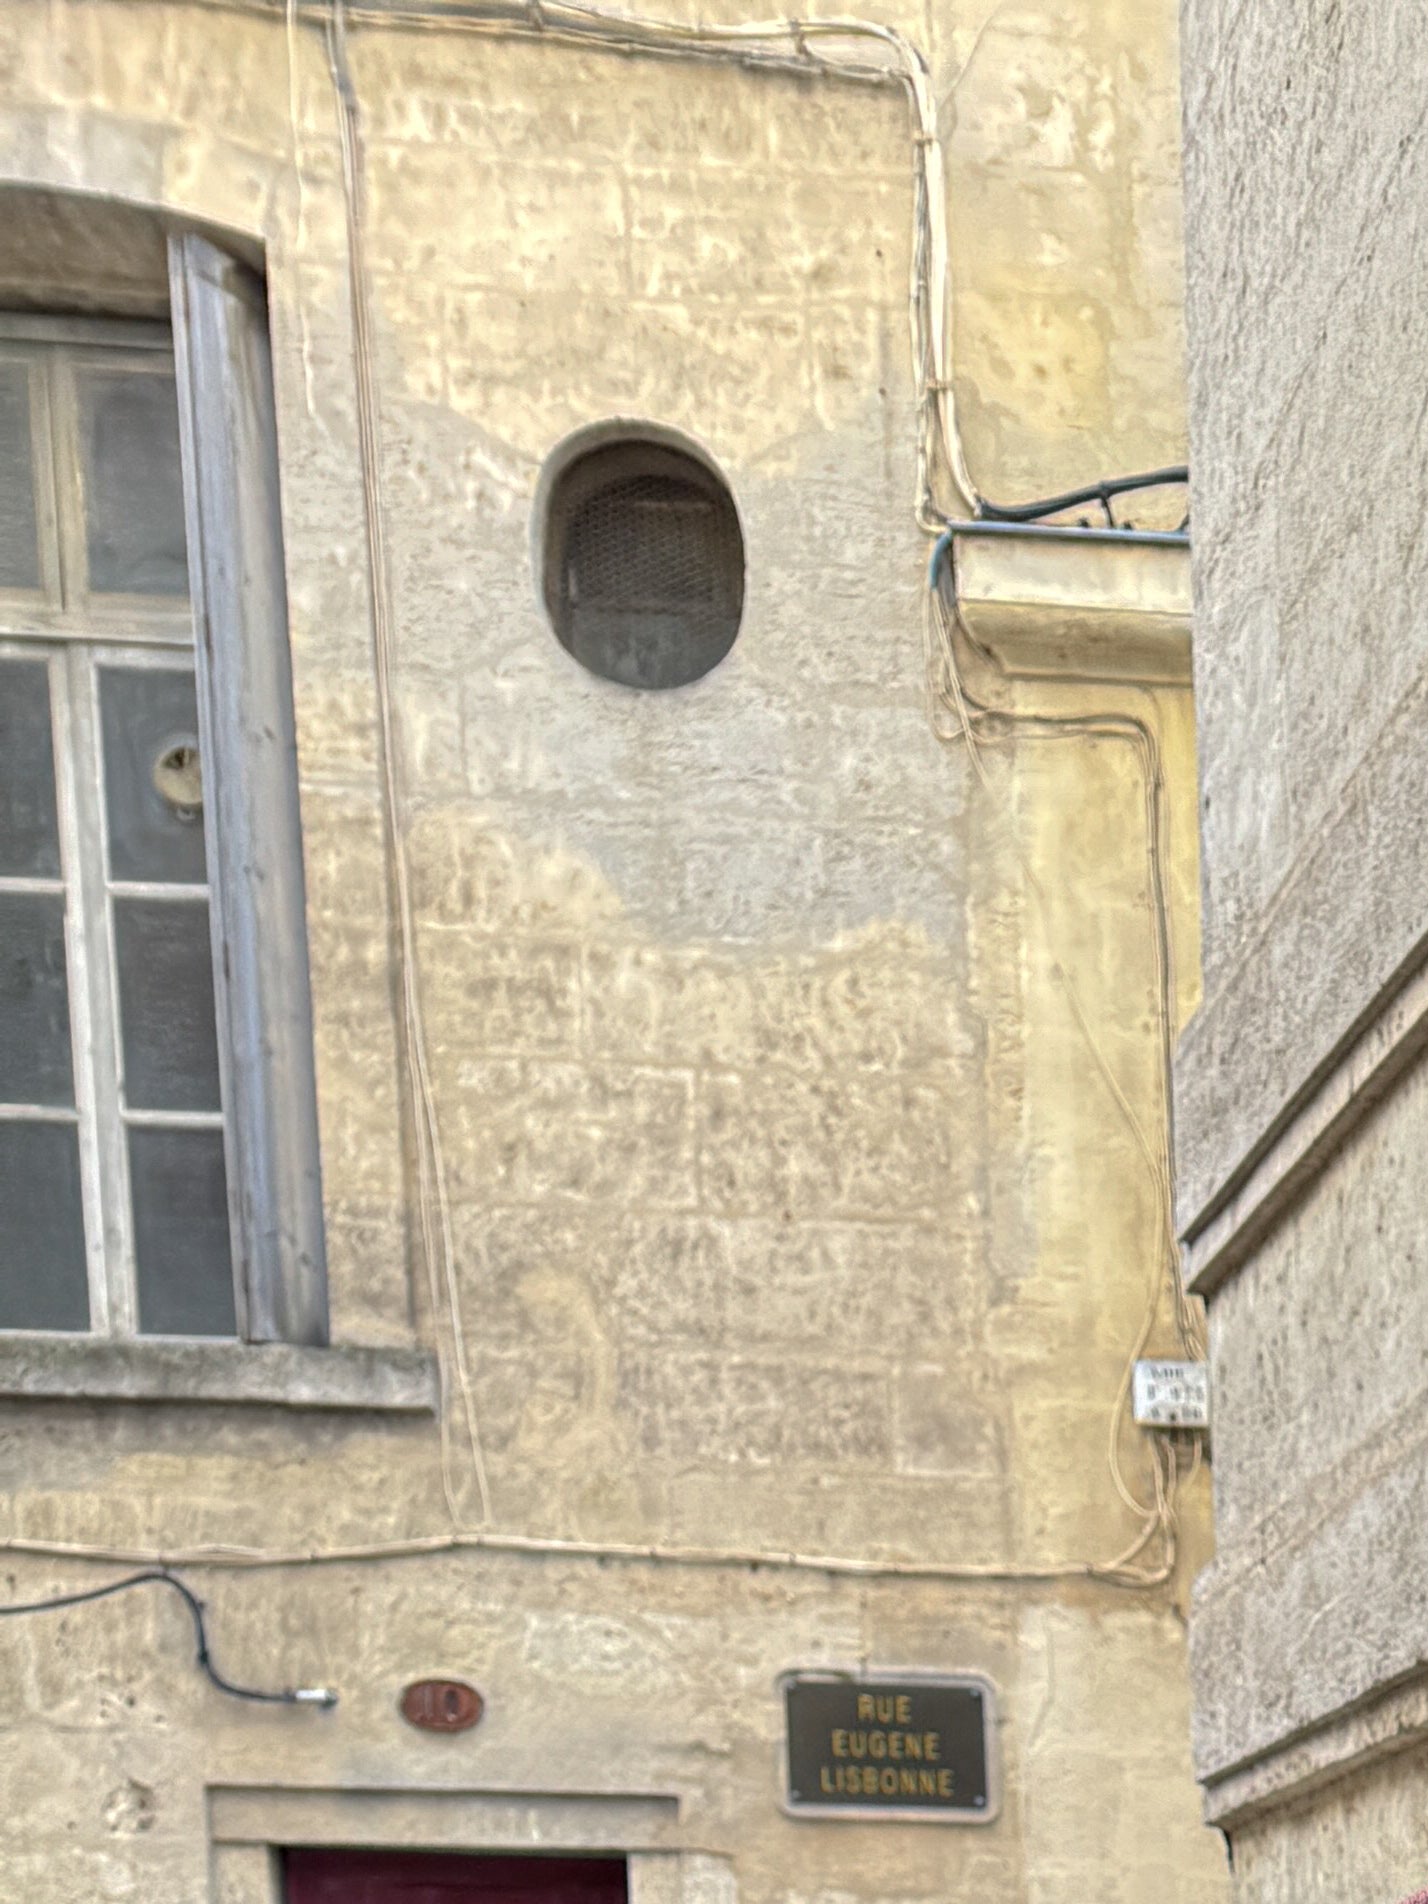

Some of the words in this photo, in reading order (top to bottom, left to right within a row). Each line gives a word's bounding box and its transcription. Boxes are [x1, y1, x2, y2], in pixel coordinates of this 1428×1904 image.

[857, 1693, 911, 1724] RUE
[831, 1729, 940, 1760] EUGENE
[820, 1765, 953, 1797] LISBONNE
